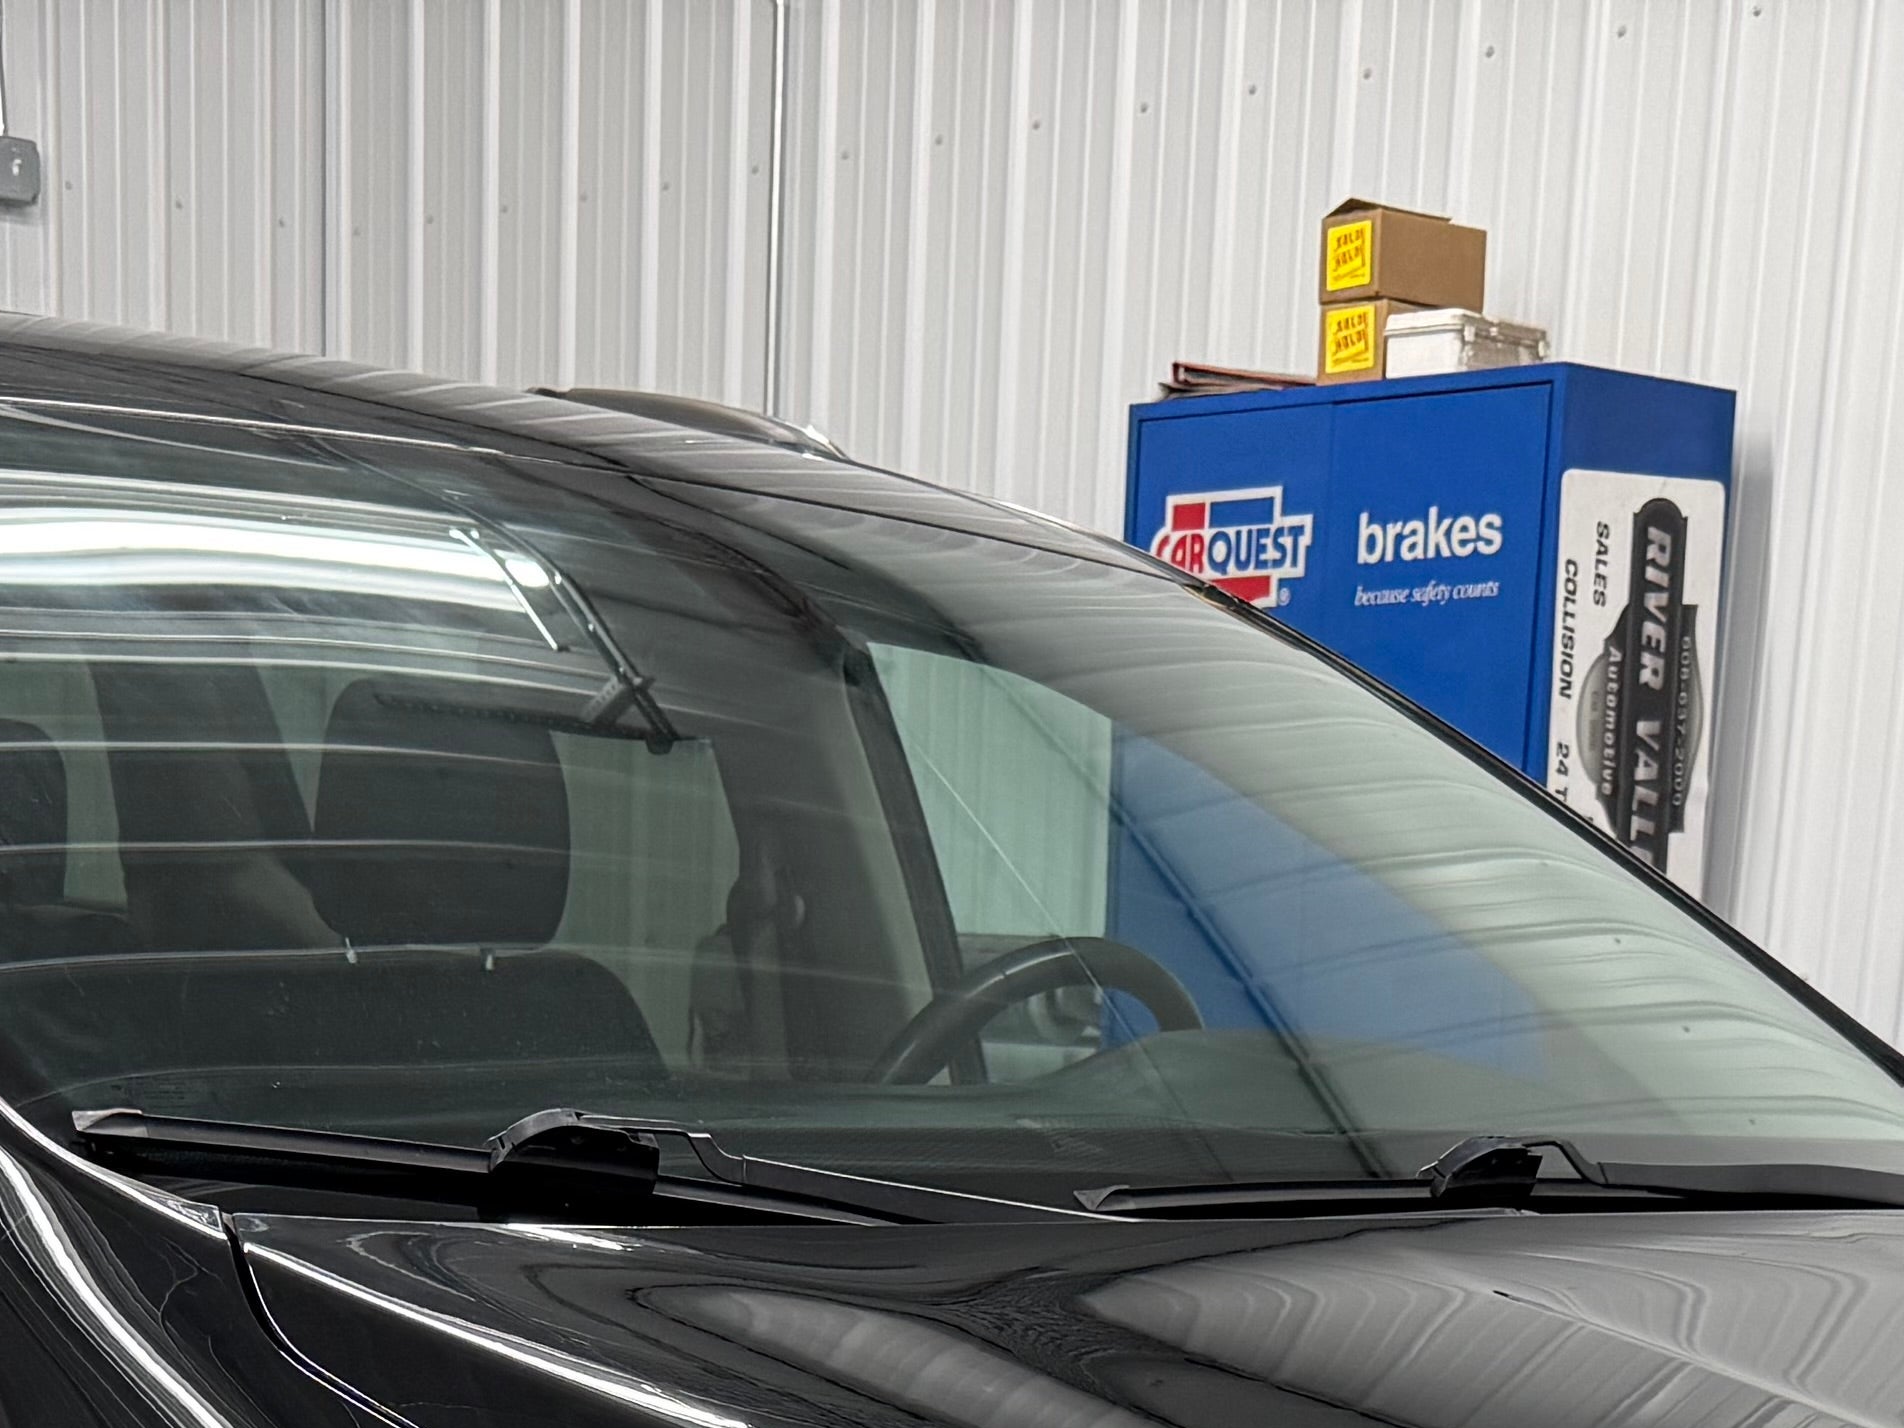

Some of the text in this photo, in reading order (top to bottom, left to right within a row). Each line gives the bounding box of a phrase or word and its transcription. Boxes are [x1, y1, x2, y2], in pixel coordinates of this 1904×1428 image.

[1356, 506, 1503, 565] brakes
[1592, 520, 1610, 607] SALES
[1354, 580, 1501, 607] because safety counts
[1559, 558, 1579, 699] COLLISION
[1600, 646, 1623, 796] Automotive
[1630, 526, 1672, 866] RIVER VALL
[1555, 742, 1571, 777] 24
